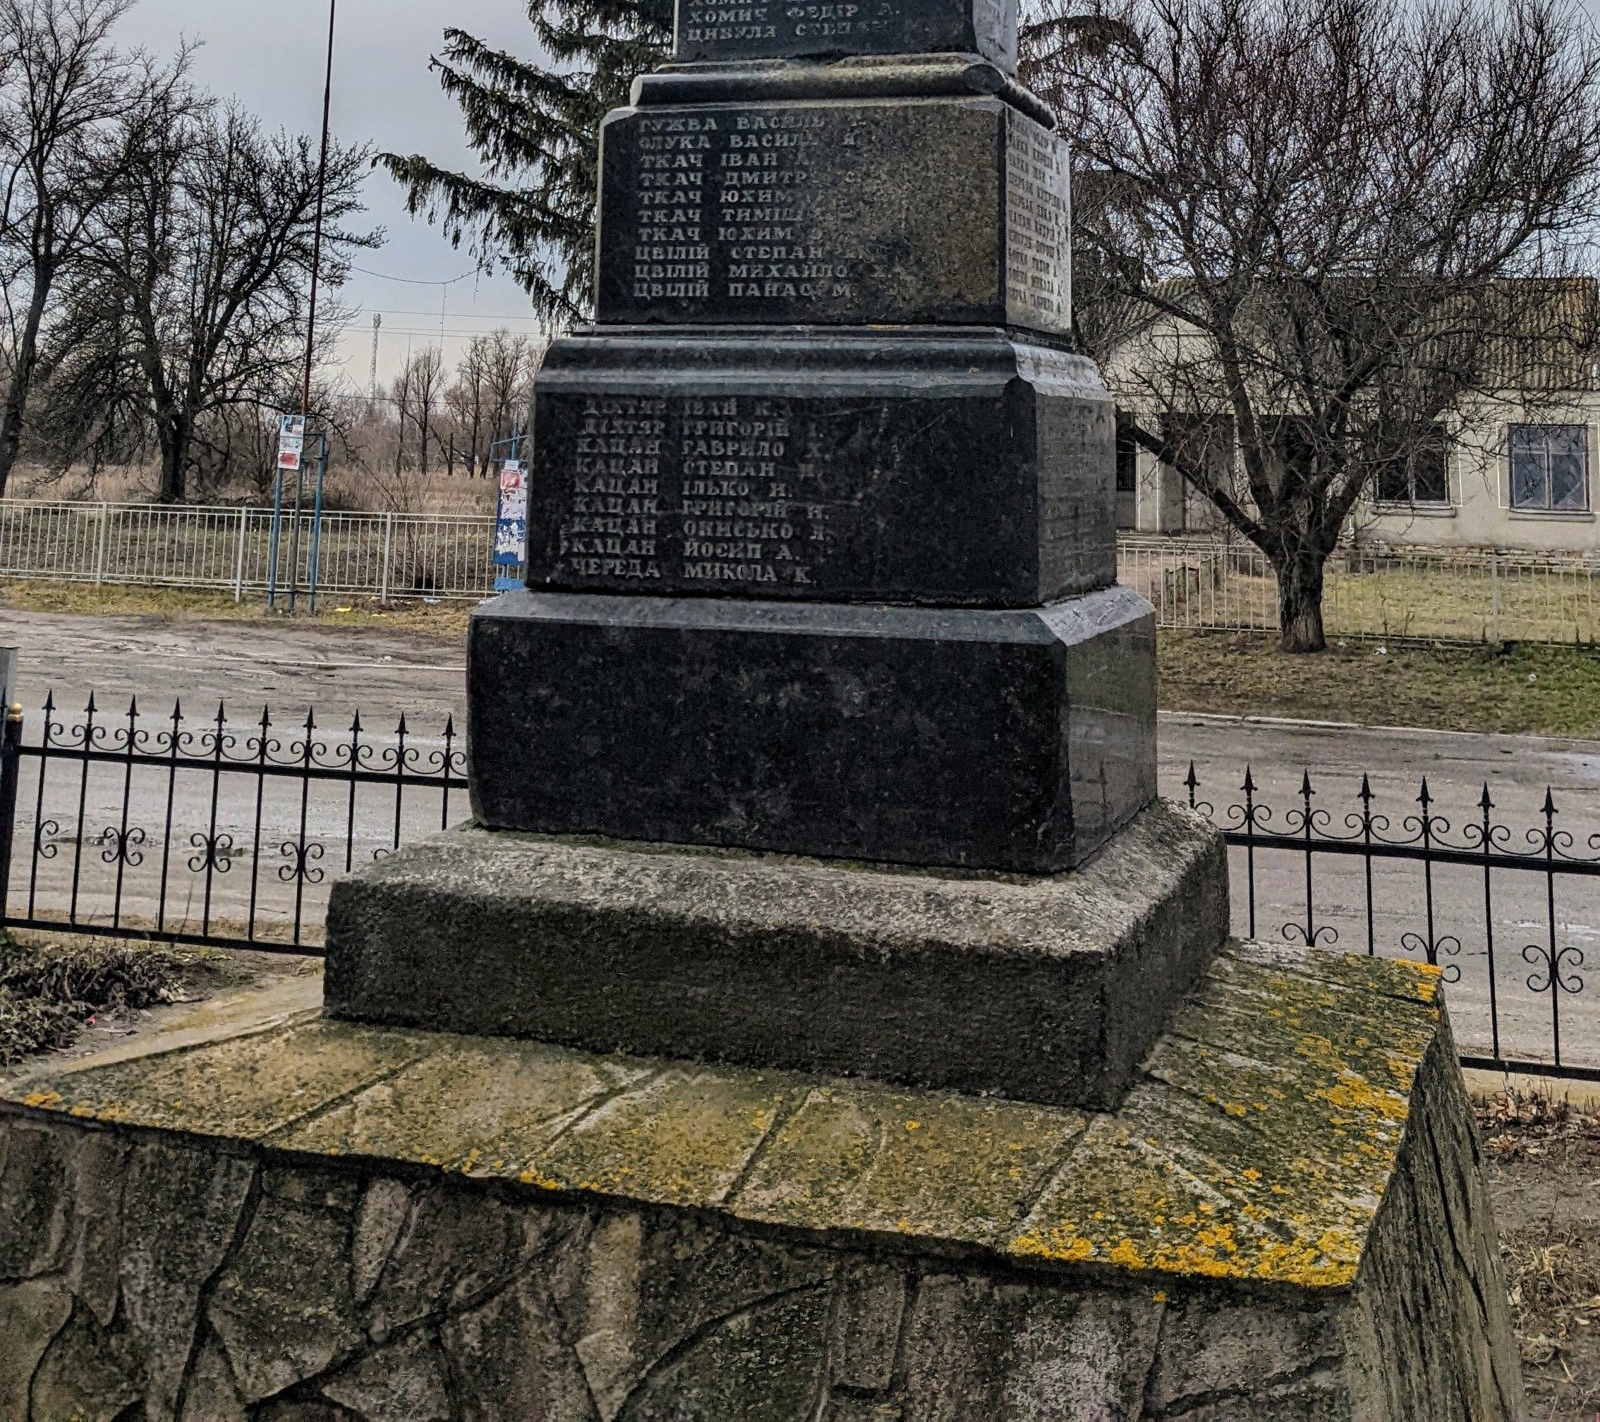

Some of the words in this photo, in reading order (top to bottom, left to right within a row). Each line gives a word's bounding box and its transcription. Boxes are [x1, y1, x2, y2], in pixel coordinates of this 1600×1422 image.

[687, 7, 769, 25] ХОМИЧ
[640, 153, 703, 168] ТКАЧ
[719, 152, 778, 167] ІВАН
[640, 171, 703, 187] ТКАЧ
[723, 171, 820, 188] ДМИТР
[638, 190, 703, 205] ТКАЧ
[719, 189, 793, 204] ЮХИМ
[637, 207, 703, 223] ТКАЧ
[637, 226, 701, 242] ТКАЧ
[717, 227, 794, 241] ЮХИМ
[634, 242, 710, 262] ЦВІЛІЙ
[730, 245, 824, 260] СТЕПАН
[633, 261, 710, 281] ЦВІЛІЙ
[728, 261, 849, 278] МИХАЙЛО
[633, 279, 710, 300] ЦВІЛІЙ
[728, 283, 813, 297] ПАНАС
[576, 438, 662, 456] КАЦАН
[682, 439, 785, 457] ГАВРИЛО
[576, 458, 659, 476] КАЦАН
[682, 459, 776, 477] СТЕПАН
[574, 477, 658, 496] КАЦАН
[681, 480, 750, 496] ІЛЬКО
[574, 497, 658, 515] КАЦАН
[682, 499, 788, 518] ГРИГОРІЙ
[571, 517, 657, 537] КАЦАН
[683, 520, 794, 539] ОНИСЬКО
[572, 538, 656, 557] КАЦАН
[683, 538, 762, 559] ЙОСИП
[570, 558, 661, 579] ЧЕРЕДА
[683, 562, 778, 582] МИКОЛА
